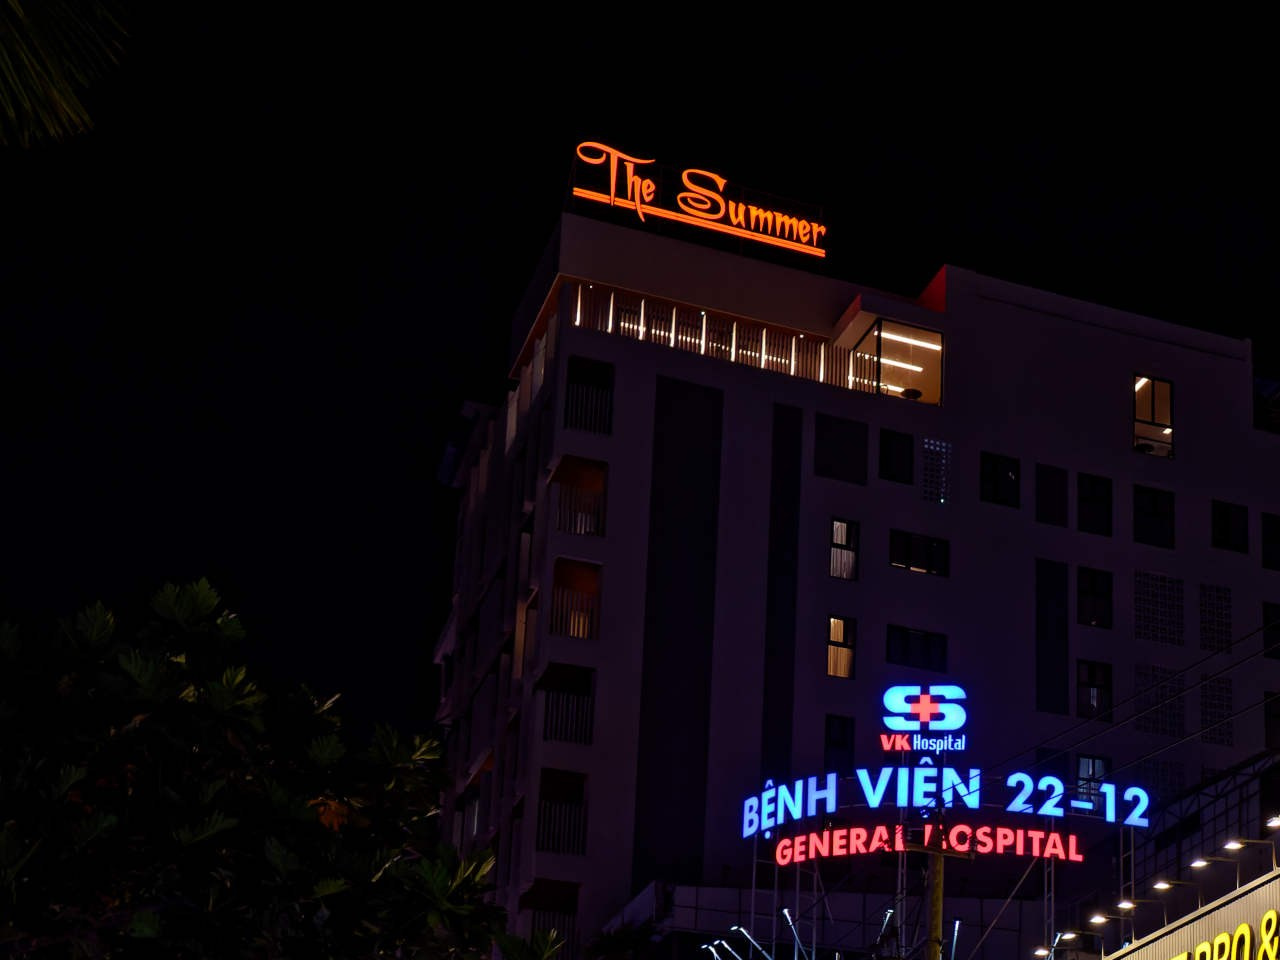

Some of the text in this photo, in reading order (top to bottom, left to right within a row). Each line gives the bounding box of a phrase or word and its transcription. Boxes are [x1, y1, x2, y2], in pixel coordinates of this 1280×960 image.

[576, 141, 827, 246] The Summer
[880, 734, 965, 755] VK Hospital
[743, 757, 1149, 840] BỆNH VIỆN 22-12
